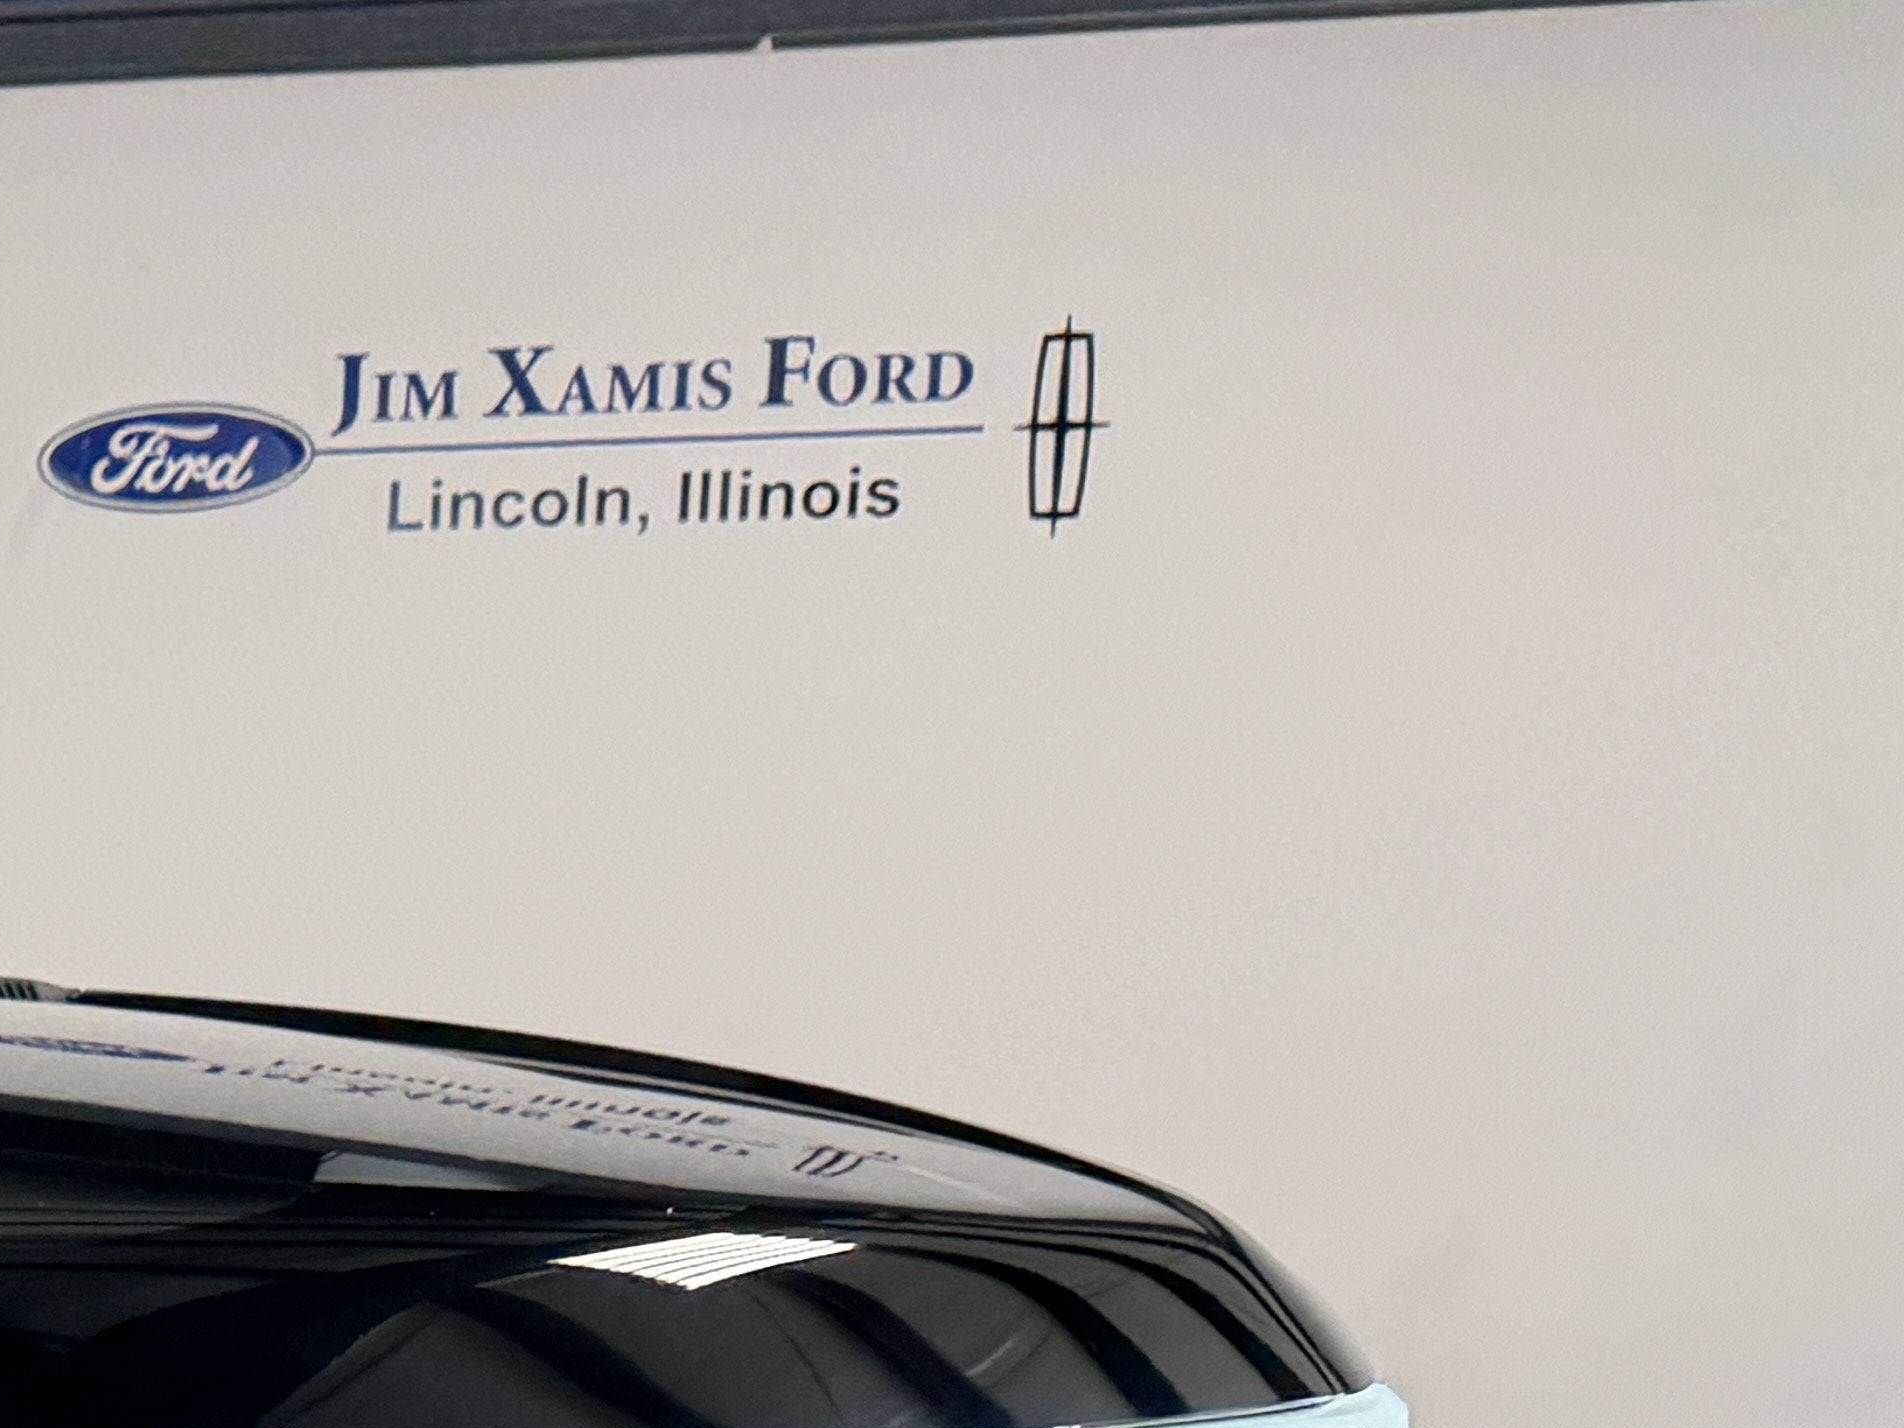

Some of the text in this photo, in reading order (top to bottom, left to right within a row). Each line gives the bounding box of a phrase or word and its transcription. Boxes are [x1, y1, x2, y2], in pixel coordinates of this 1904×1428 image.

[331, 334, 975, 437] JIM XAMIS FORD
[91, 422, 260, 495] Ford
[387, 465, 901, 535] Lincoln, Illinois
